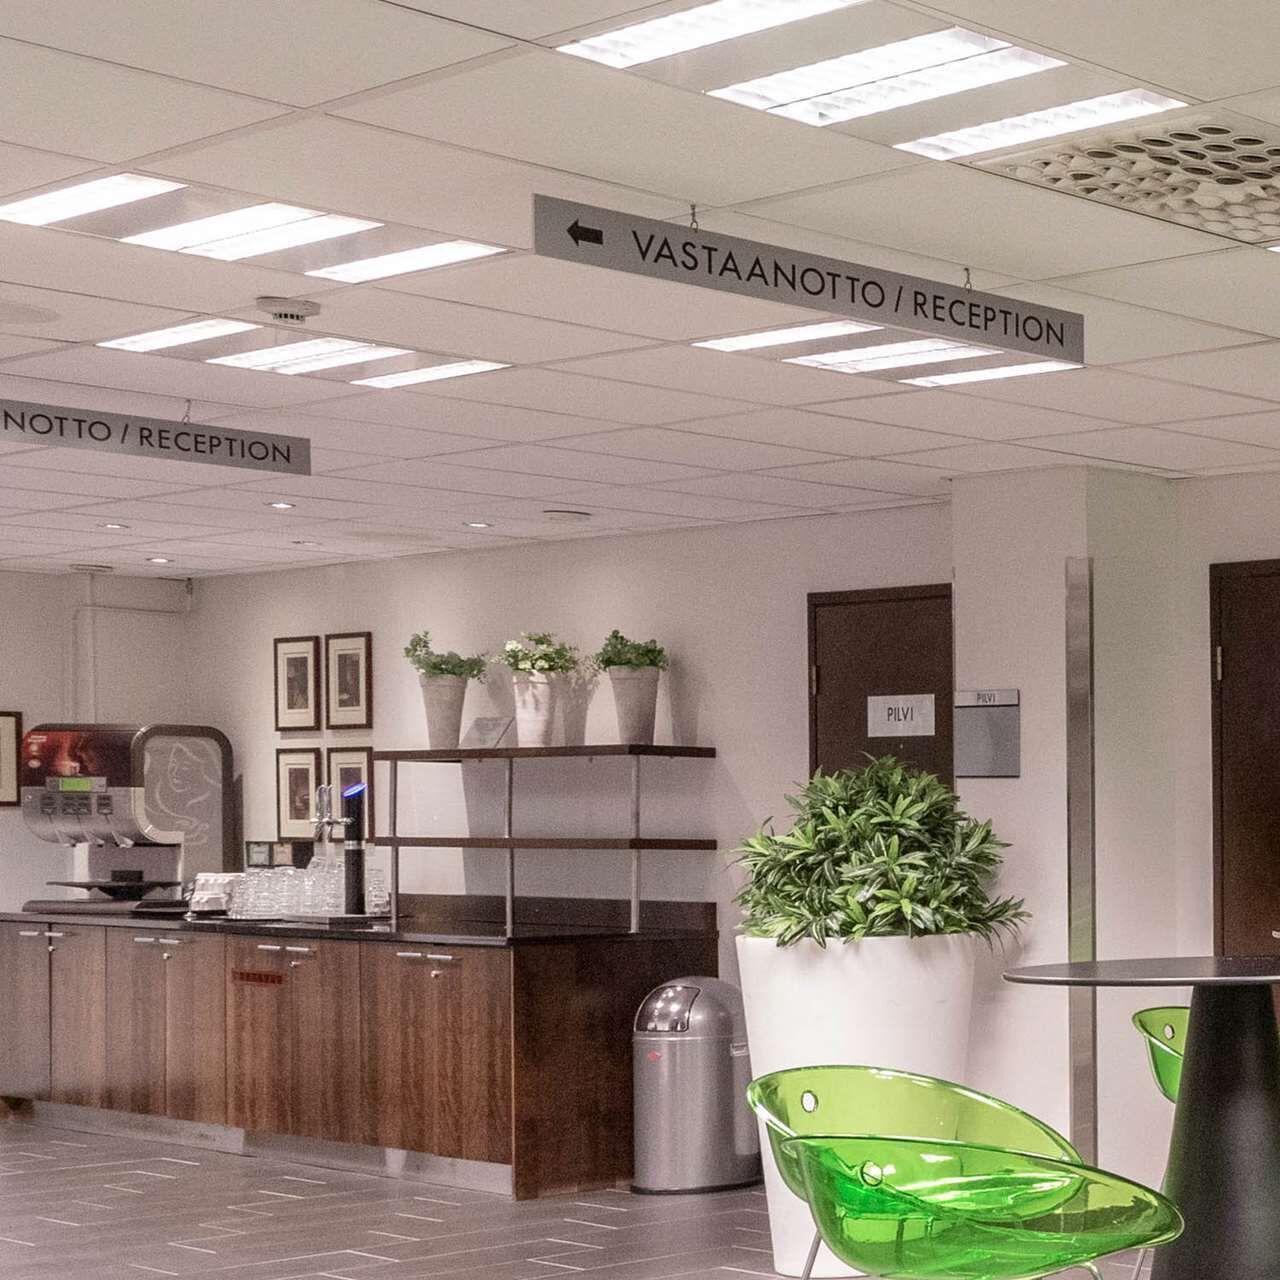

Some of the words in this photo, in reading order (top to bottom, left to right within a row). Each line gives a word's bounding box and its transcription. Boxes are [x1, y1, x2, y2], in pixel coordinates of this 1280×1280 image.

[631, 229, 887, 309] VASTAANOTTO
[894, 284, 904, 312] /
[912, 289, 1066, 347] RECEPTION
[2, 409, 112, 442] NOTTO
[120, 424, 129, 444] /
[139, 426, 292, 464] RECEPTION
[887, 706, 914, 722] PILVI
[976, 693, 996, 703] PILVI
